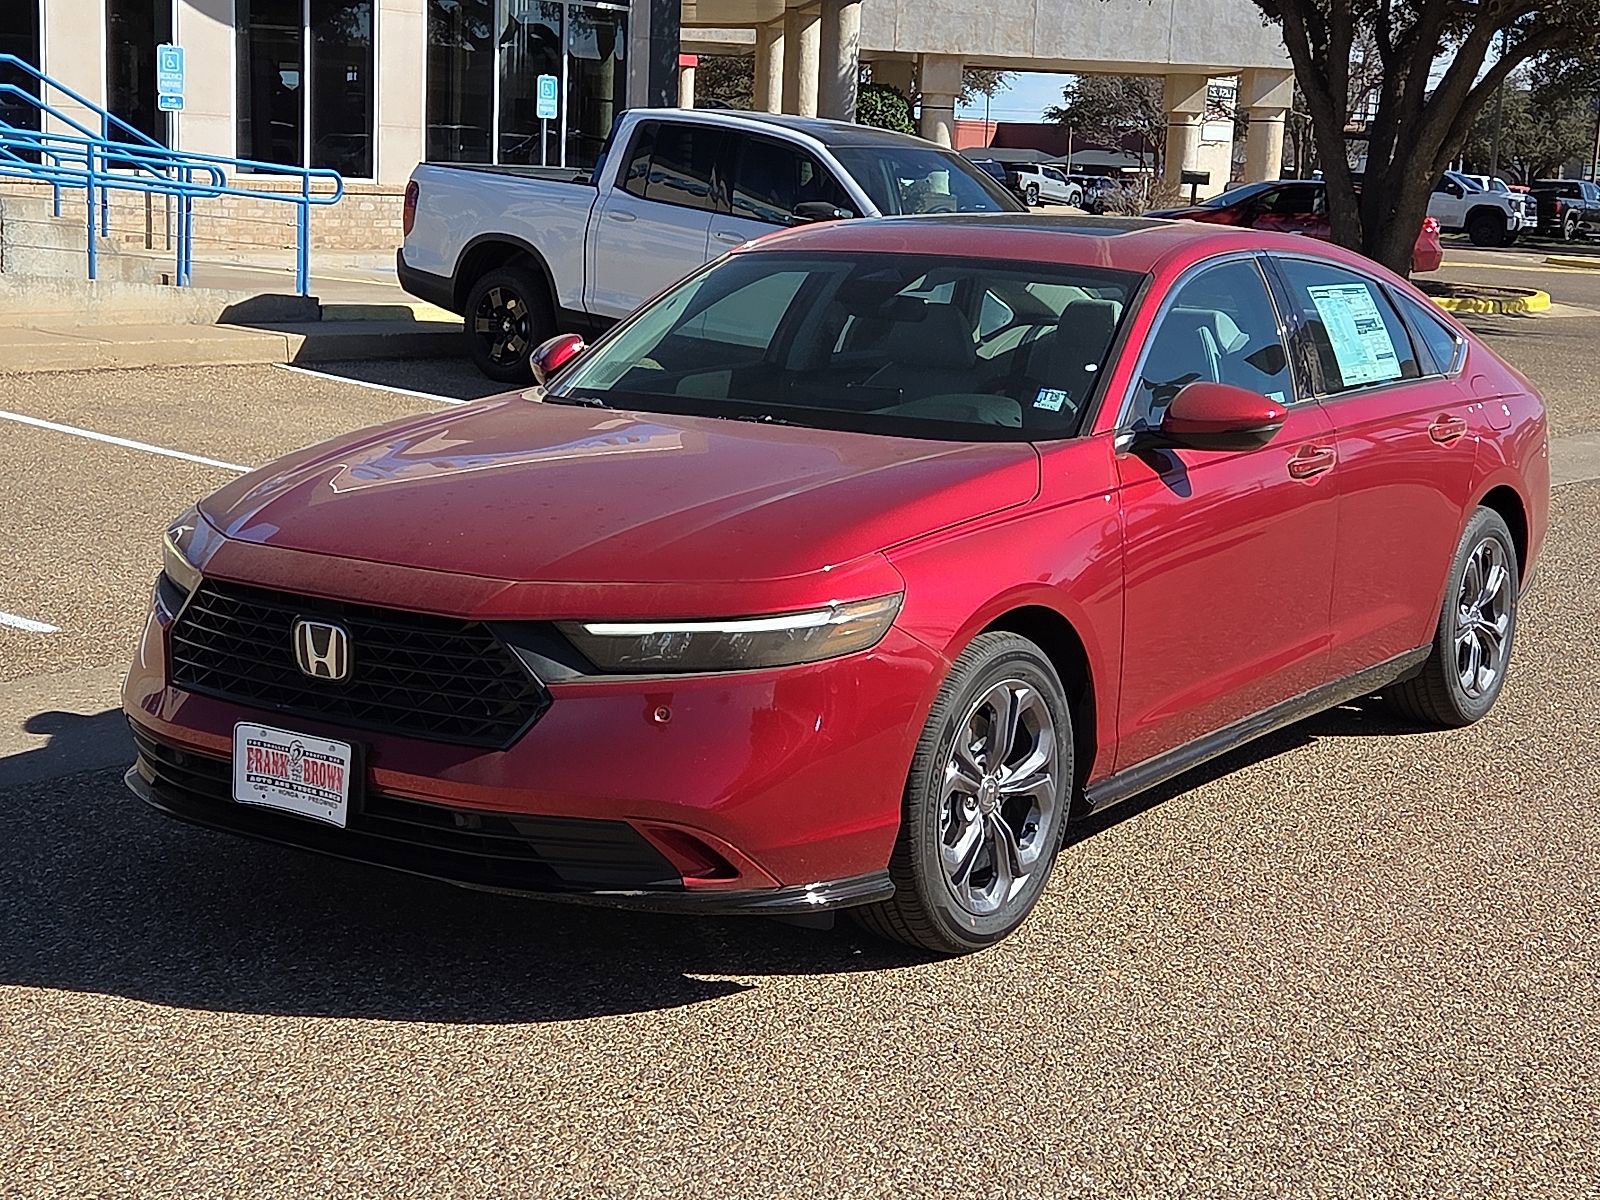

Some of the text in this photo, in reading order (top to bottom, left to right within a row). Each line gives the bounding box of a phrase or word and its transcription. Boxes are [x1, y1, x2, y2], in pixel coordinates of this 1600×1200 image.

[246, 747, 344, 795] FRANK BROWN
[249, 776, 273, 785] AUTO
[274, 780, 290, 788] AND
[292, 783, 317, 795] TRUCK
[253, 784, 269, 792] GMC
[278, 789, 300, 799] HONDA
